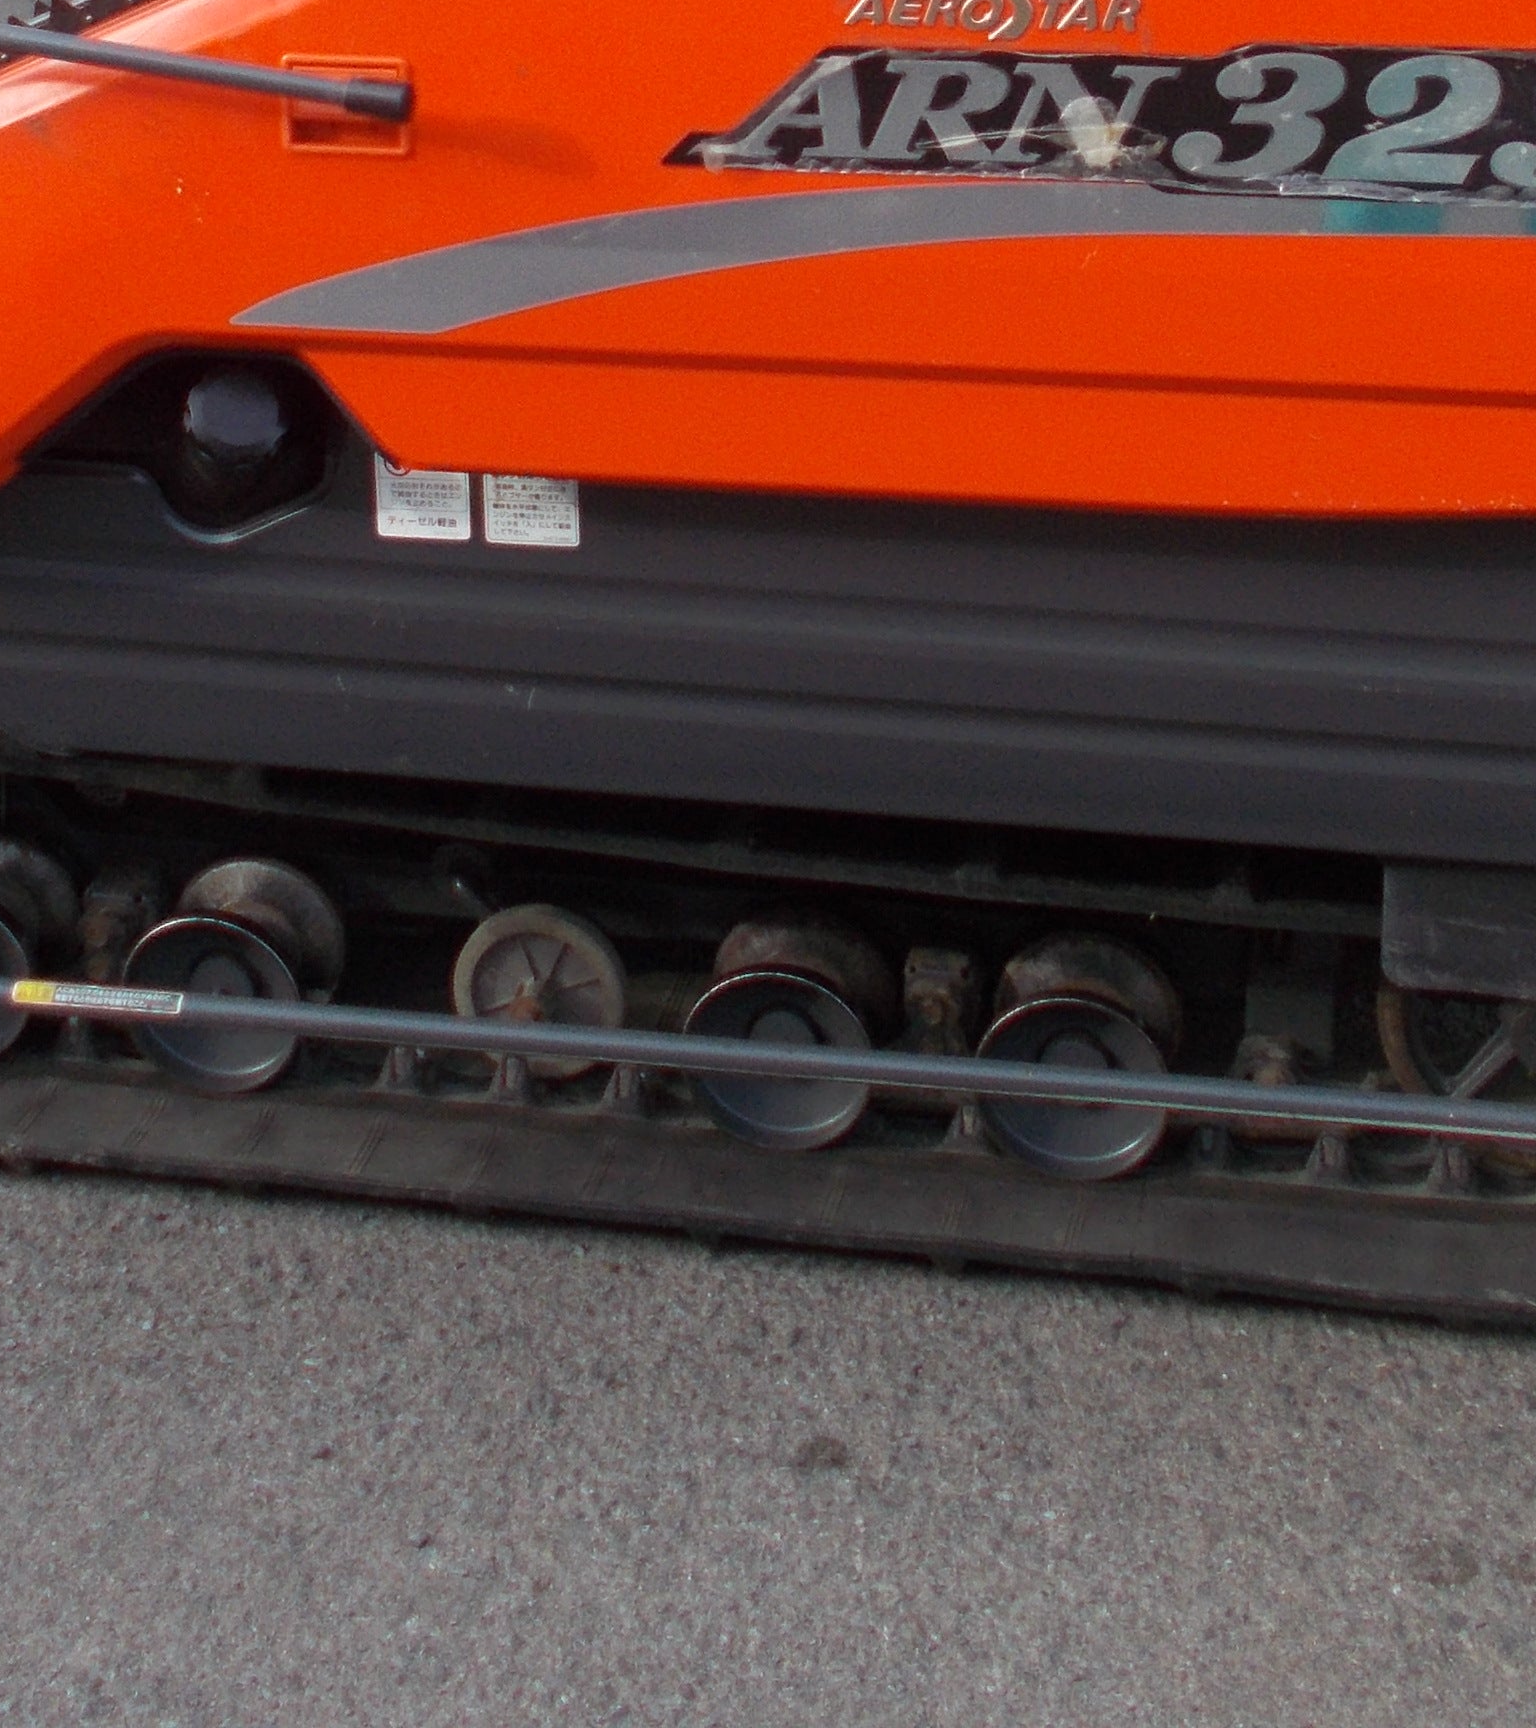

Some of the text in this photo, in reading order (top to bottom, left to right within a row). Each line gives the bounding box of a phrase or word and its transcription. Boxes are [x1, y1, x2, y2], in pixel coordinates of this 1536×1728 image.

[387, 516, 457, 528] ディーゼル軽油
